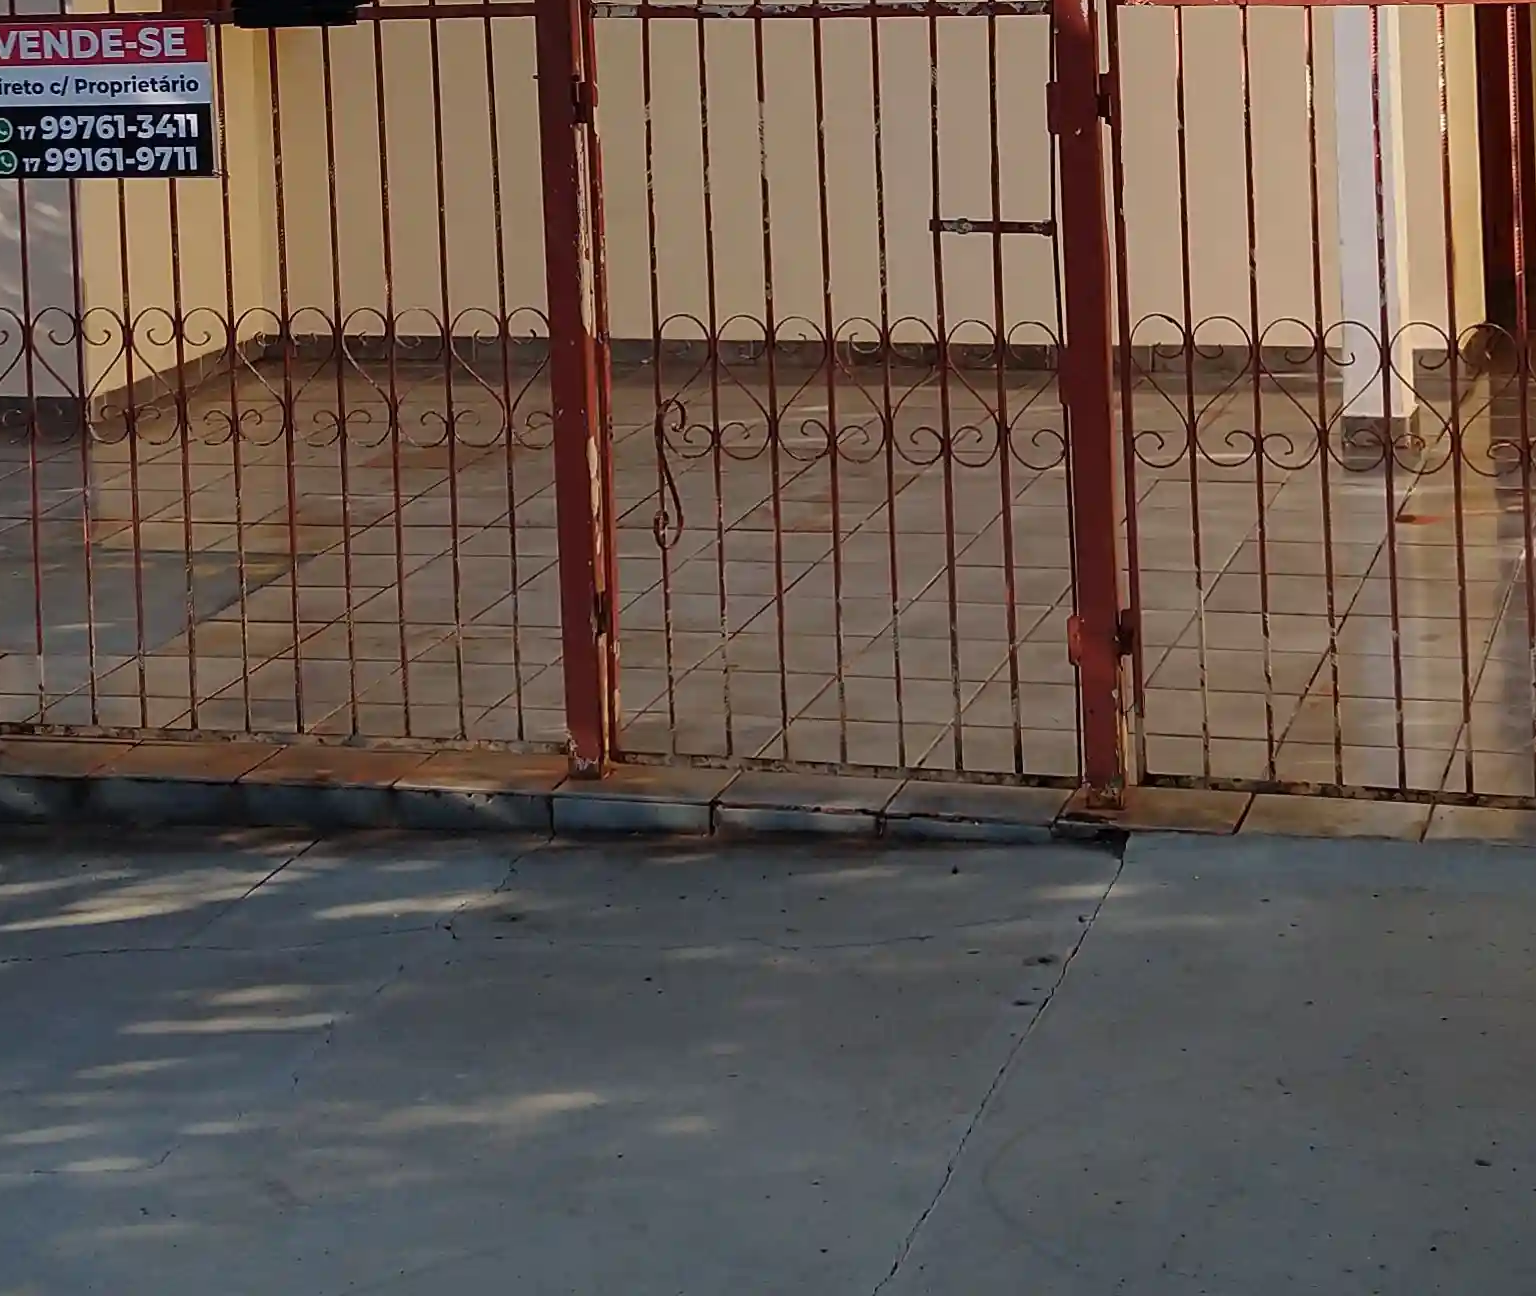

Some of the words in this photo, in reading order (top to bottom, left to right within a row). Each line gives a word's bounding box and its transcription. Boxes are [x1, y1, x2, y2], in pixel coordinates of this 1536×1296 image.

[49, 75, 69, 97] c/
[75, 74, 199, 98] Proprietário
[17, 125, 36, 140] 17
[40, 113, 199, 140] 99761-3411
[22, 157, 41, 172] 17
[45, 146, 198, 173] 99161-9711
